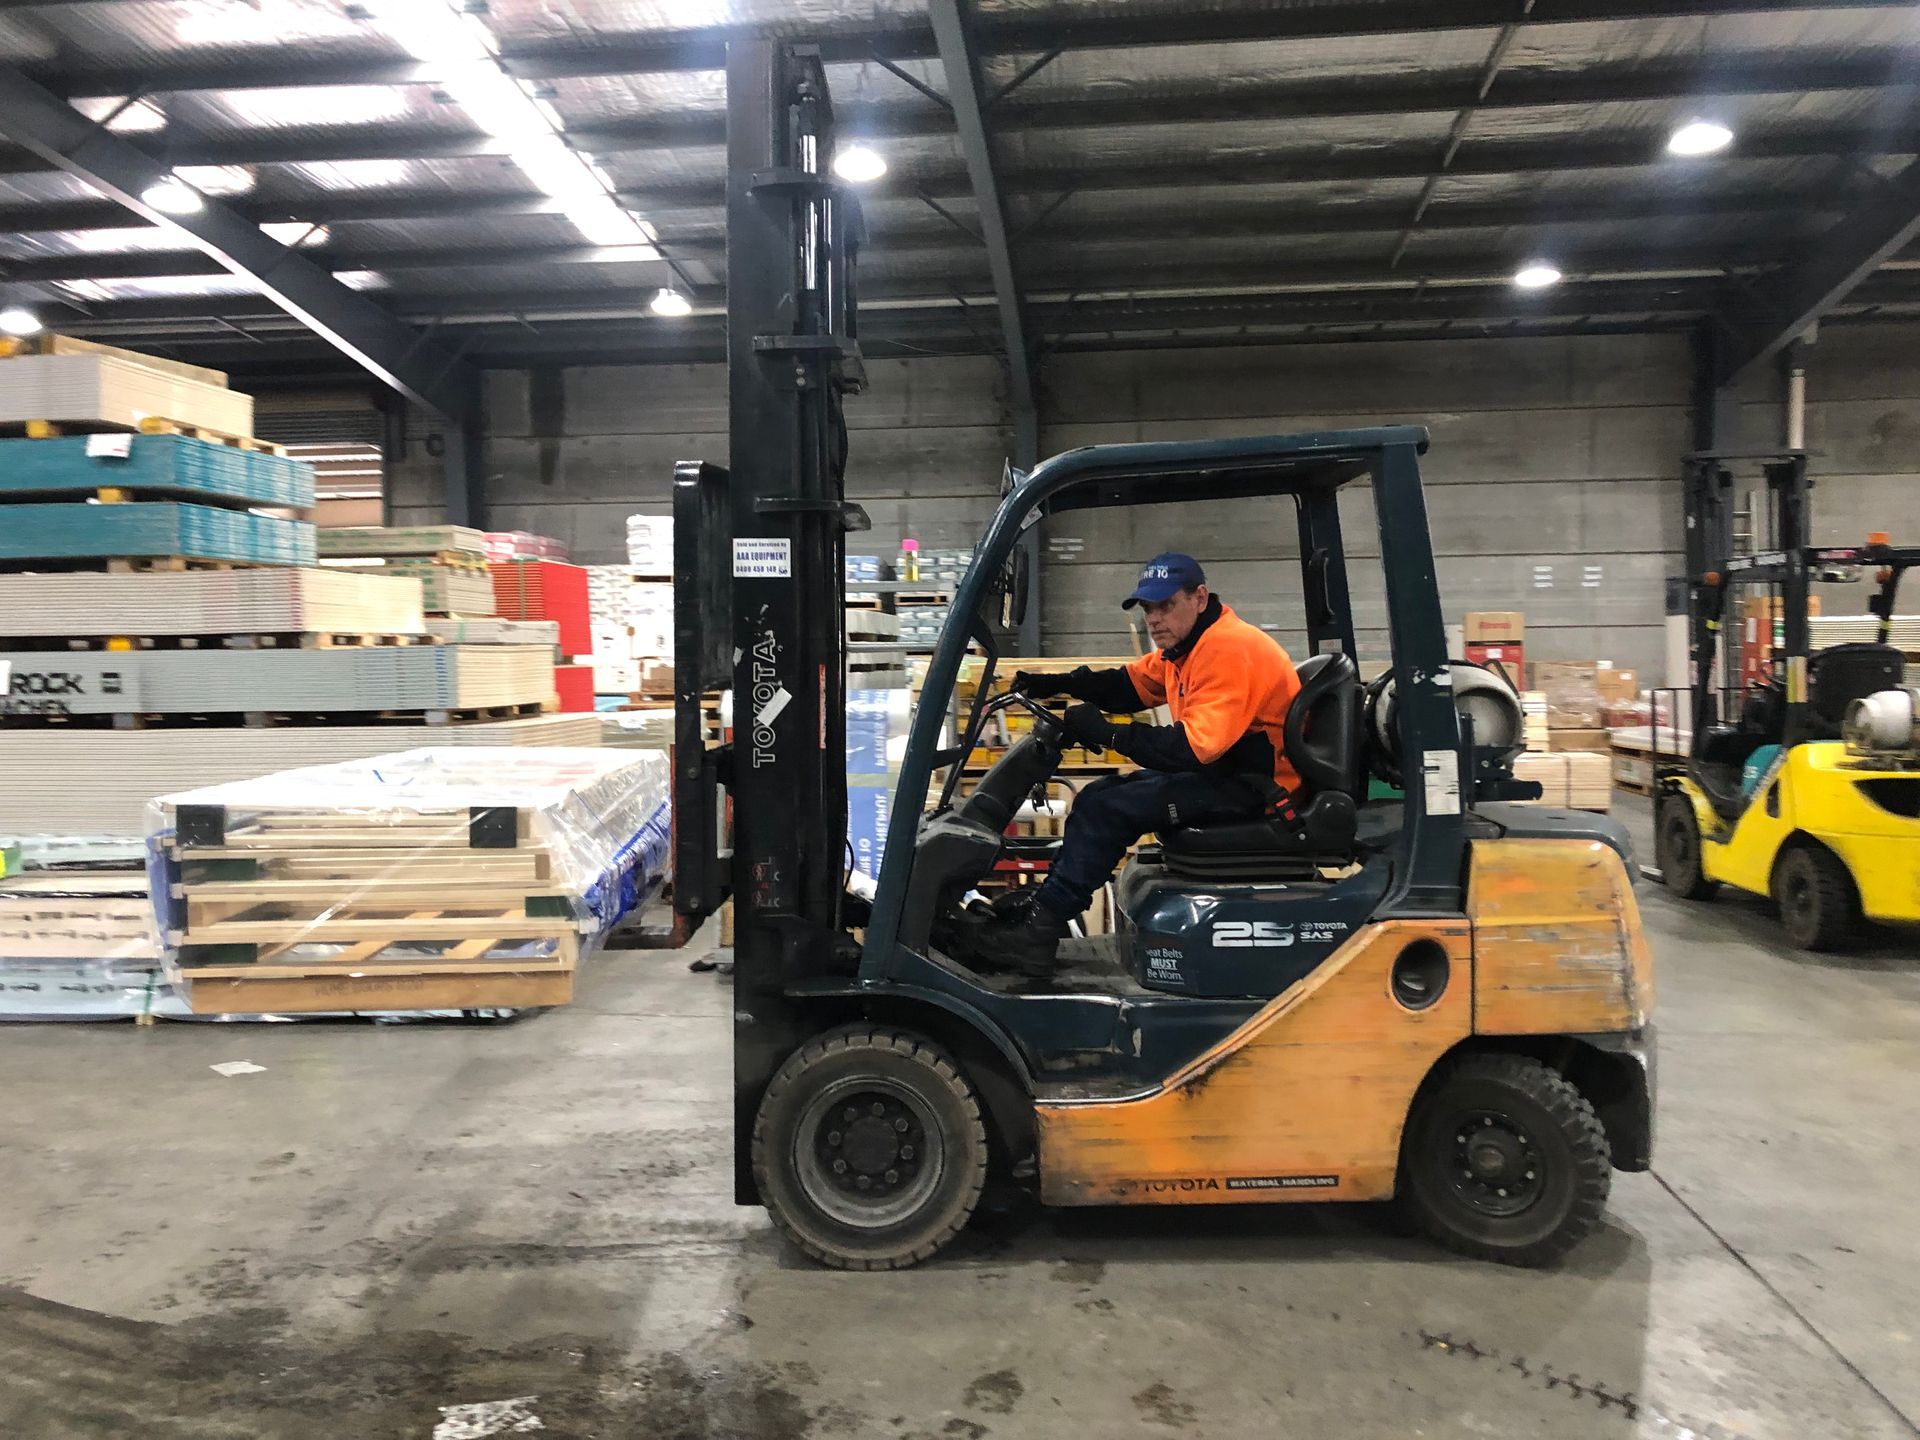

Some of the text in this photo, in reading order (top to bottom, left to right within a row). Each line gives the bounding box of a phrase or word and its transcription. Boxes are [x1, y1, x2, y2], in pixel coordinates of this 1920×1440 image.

[736, 552, 787, 561] AAA EQUIPMENT
[1157, 568, 1168, 579] 10
[1312, 922, 1349, 930] TOYOTA
[1212, 921, 1295, 947] 25
[1300, 931, 1334, 939] SAS
[1162, 948, 1184, 959] Belts
[1150, 957, 1177, 970] MUST
[1146, 968, 1158, 979] Be
[1142, 1177, 1220, 1193] TOYOTA
[1230, 1177, 1336, 1188] MATERIAL HANDLING
